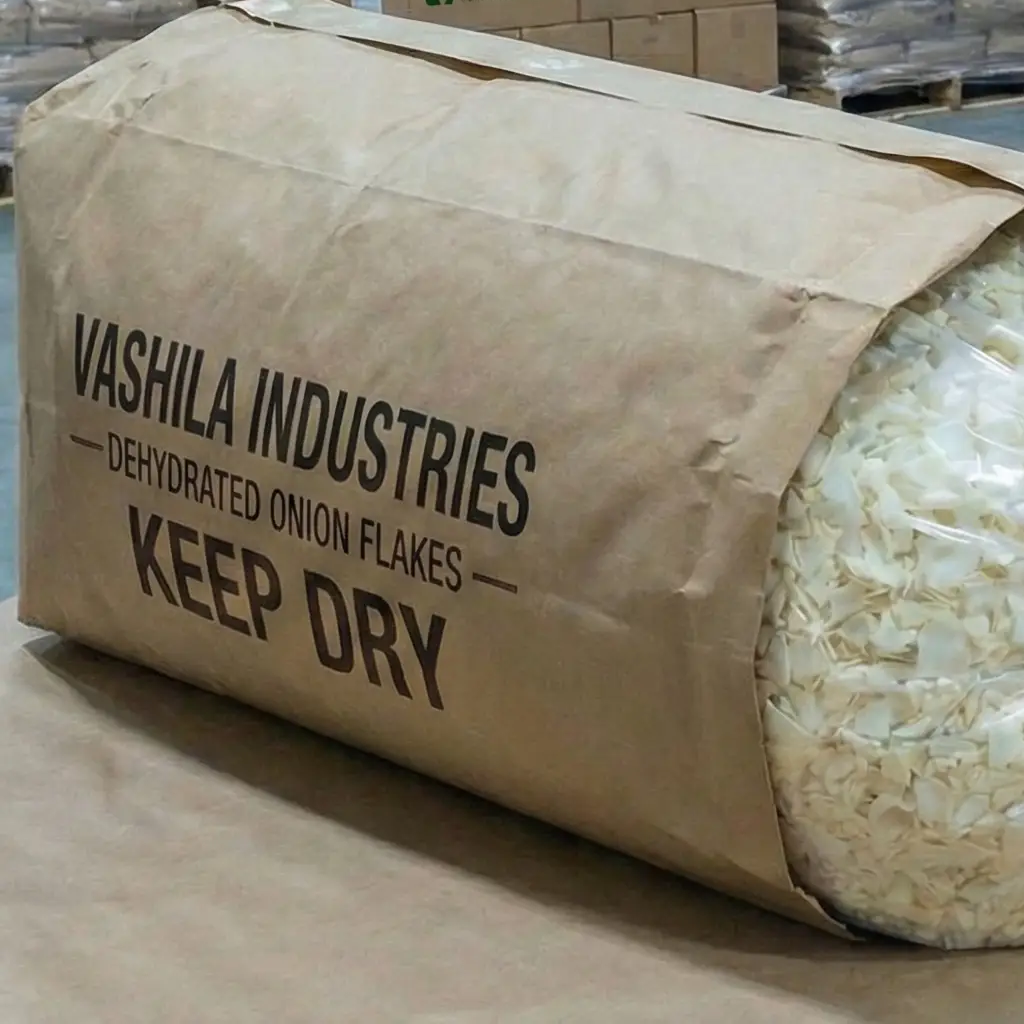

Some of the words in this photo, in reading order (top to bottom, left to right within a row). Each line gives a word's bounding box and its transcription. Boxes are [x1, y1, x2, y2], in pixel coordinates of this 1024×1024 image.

[75, 313, 237, 447] VASHILA
[248, 367, 536, 537] INDUSTRIES
[108, 431, 261, 522] DEHYDRATED
[270, 488, 350, 555] ONION
[360, 517, 463, 593] FLAKES
[128, 505, 282, 642] KEEP
[303, 568, 446, 711] DRY
